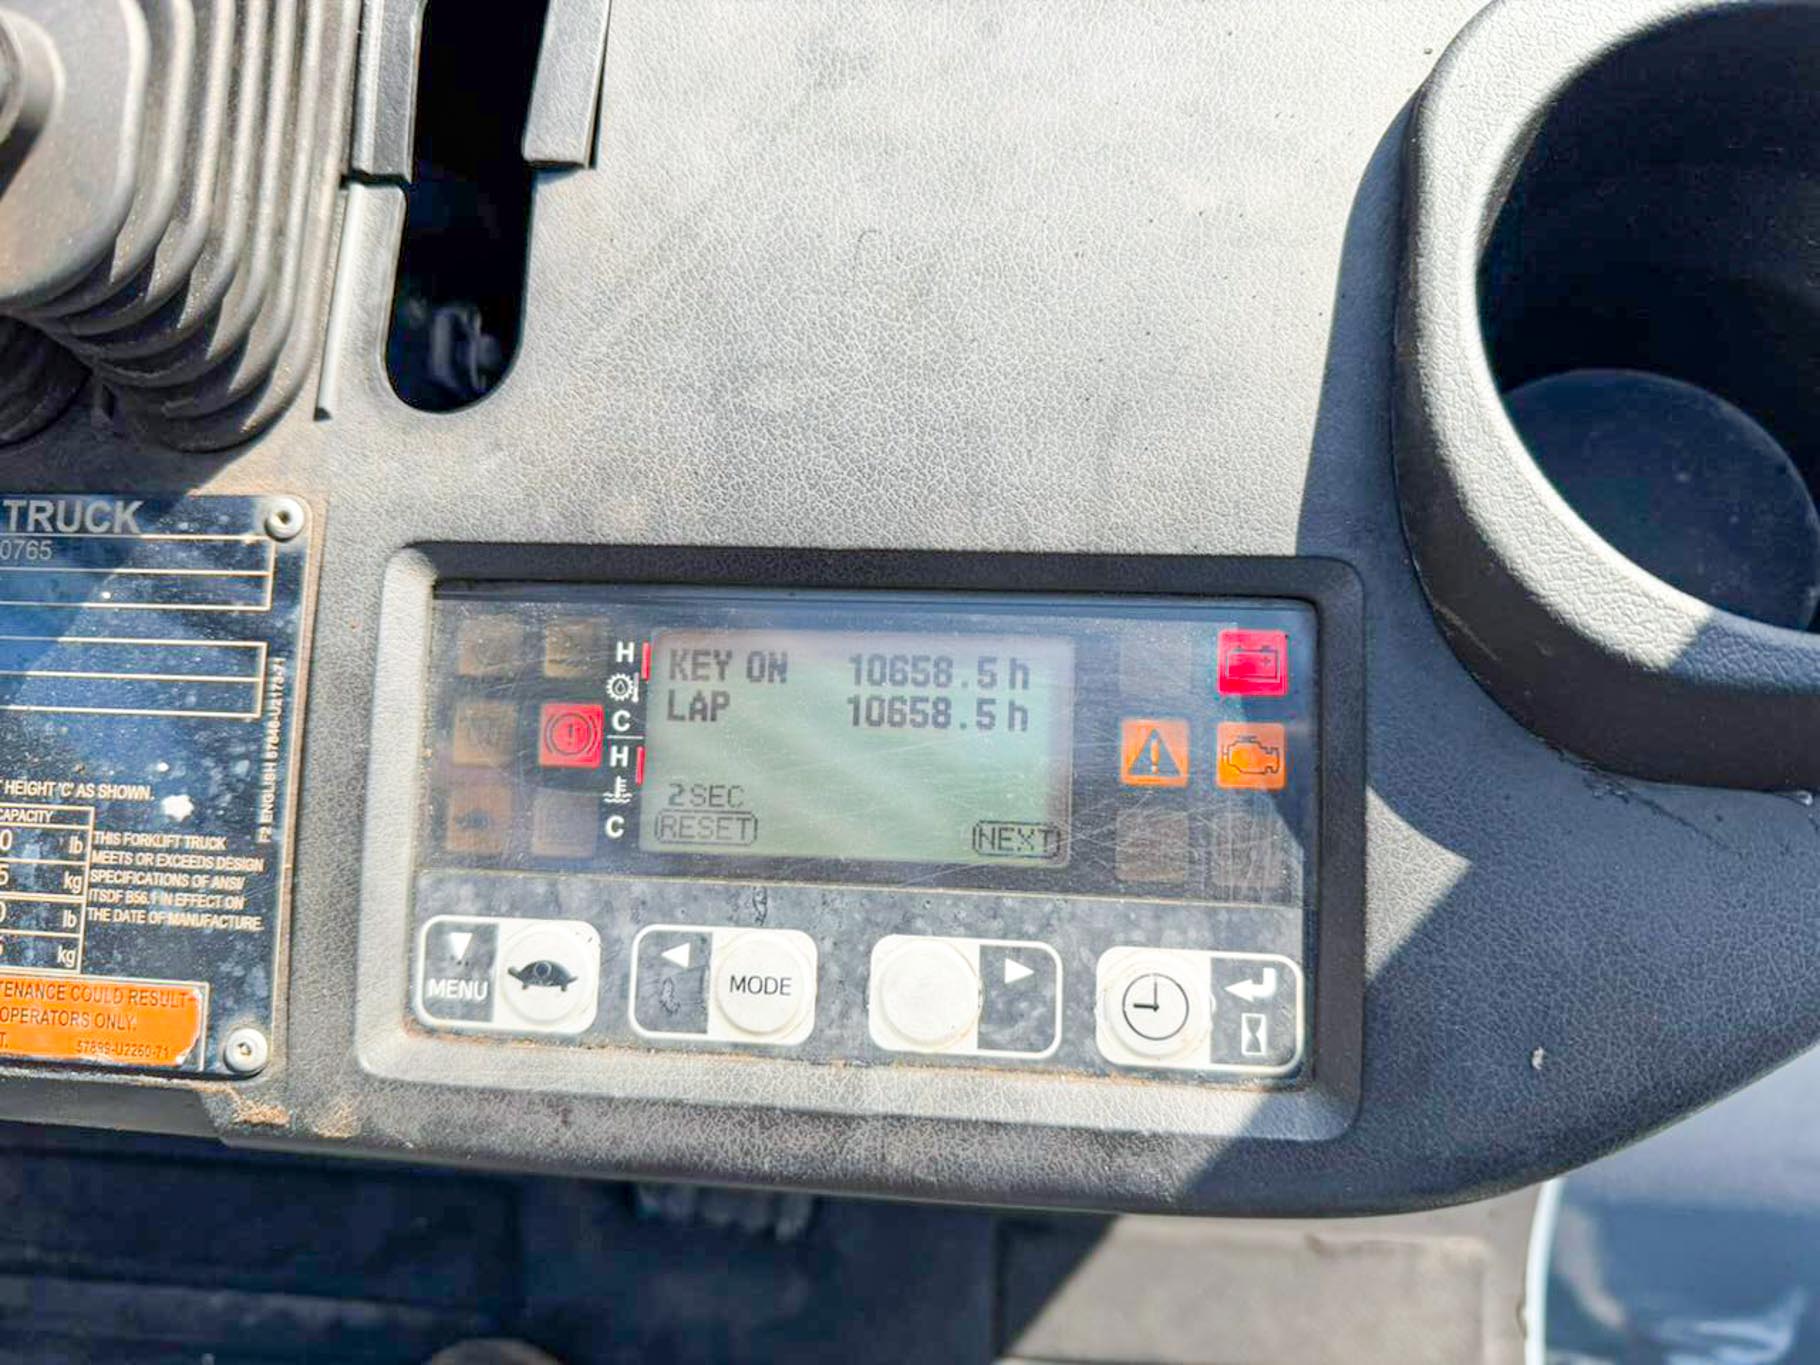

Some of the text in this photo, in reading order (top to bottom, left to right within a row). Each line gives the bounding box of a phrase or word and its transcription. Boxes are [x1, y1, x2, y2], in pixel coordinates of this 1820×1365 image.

[2, 500, 145, 533] TRUCK
[0, 540, 52, 560] 0765
[616, 642, 634, 663] H
[668, 649, 733, 683] KEY
[746, 651, 789, 685] ON
[666, 690, 731, 723] LAP
[611, 711, 631, 733] C
[609, 746, 629, 767] H
[5, 780, 55, 796] HEIGHT
[76, 783, 95, 799] AS
[98, 784, 155, 801] SHOWN.
[605, 816, 625, 839] C
[659, 816, 751, 840] RESET
[69, 836, 83, 855] lb
[94, 831, 227, 850] THIS FORKLIFT TRUCK
[978, 826, 1053, 852] NEXT
[92, 850, 265, 872] MEETS OR EXCEEDS DESIGN
[64, 871, 82, 893] kg
[90, 869, 190, 887] SPECIFICATIONS
[192, 875, 210, 888] OF
[175, 893, 222, 908] EFFECT
[225, 896, 244, 910] ON
[62, 910, 77, 928] lb
[87, 907, 112, 921] THE
[113, 909, 146, 923] DATE
[149, 911, 166, 924] OF
[57, 946, 76, 967] kg
[71, 985, 123, 1004] COULD
[128, 989, 188, 1008] RESULT
[427, 978, 488, 1002] MENU
[729, 975, 792, 997] MODE
[0, 1006, 90, 1028] OPERATORS
